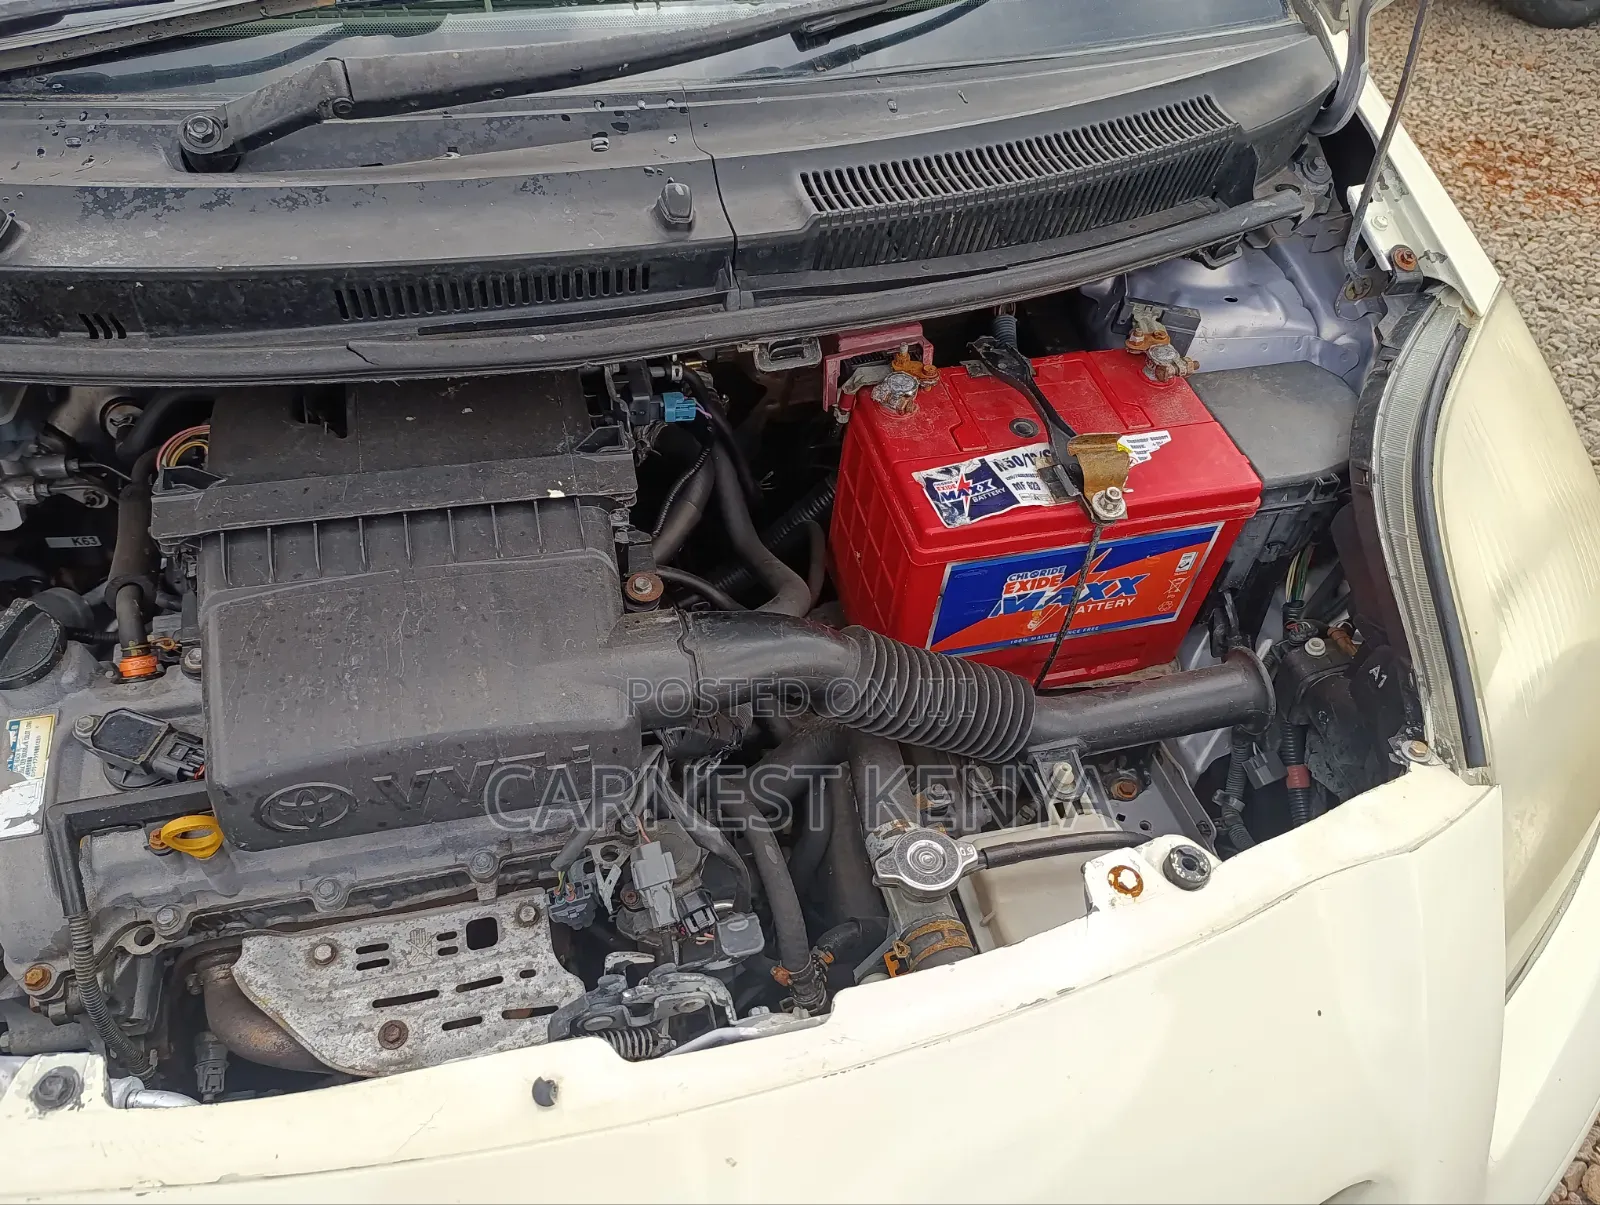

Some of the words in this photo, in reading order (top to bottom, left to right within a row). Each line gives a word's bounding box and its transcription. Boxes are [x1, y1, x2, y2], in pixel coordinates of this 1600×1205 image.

[936, 483, 957, 492] EXIDE
[939, 478, 997, 503] MAXX
[972, 486, 1006, 503] BATTERY
[71, 536, 98, 546] K63
[1006, 565, 1067, 583] CHLORIDE
[1003, 573, 1065, 595] EXIDE
[988, 574, 1150, 618] MAXX
[1066, 597, 1136, 616] ATTERY
[1010, 636, 1029, 645] 100%
[1031, 628, 1081, 642] MAINTENCE
[1082, 626, 1100, 634] FREE
